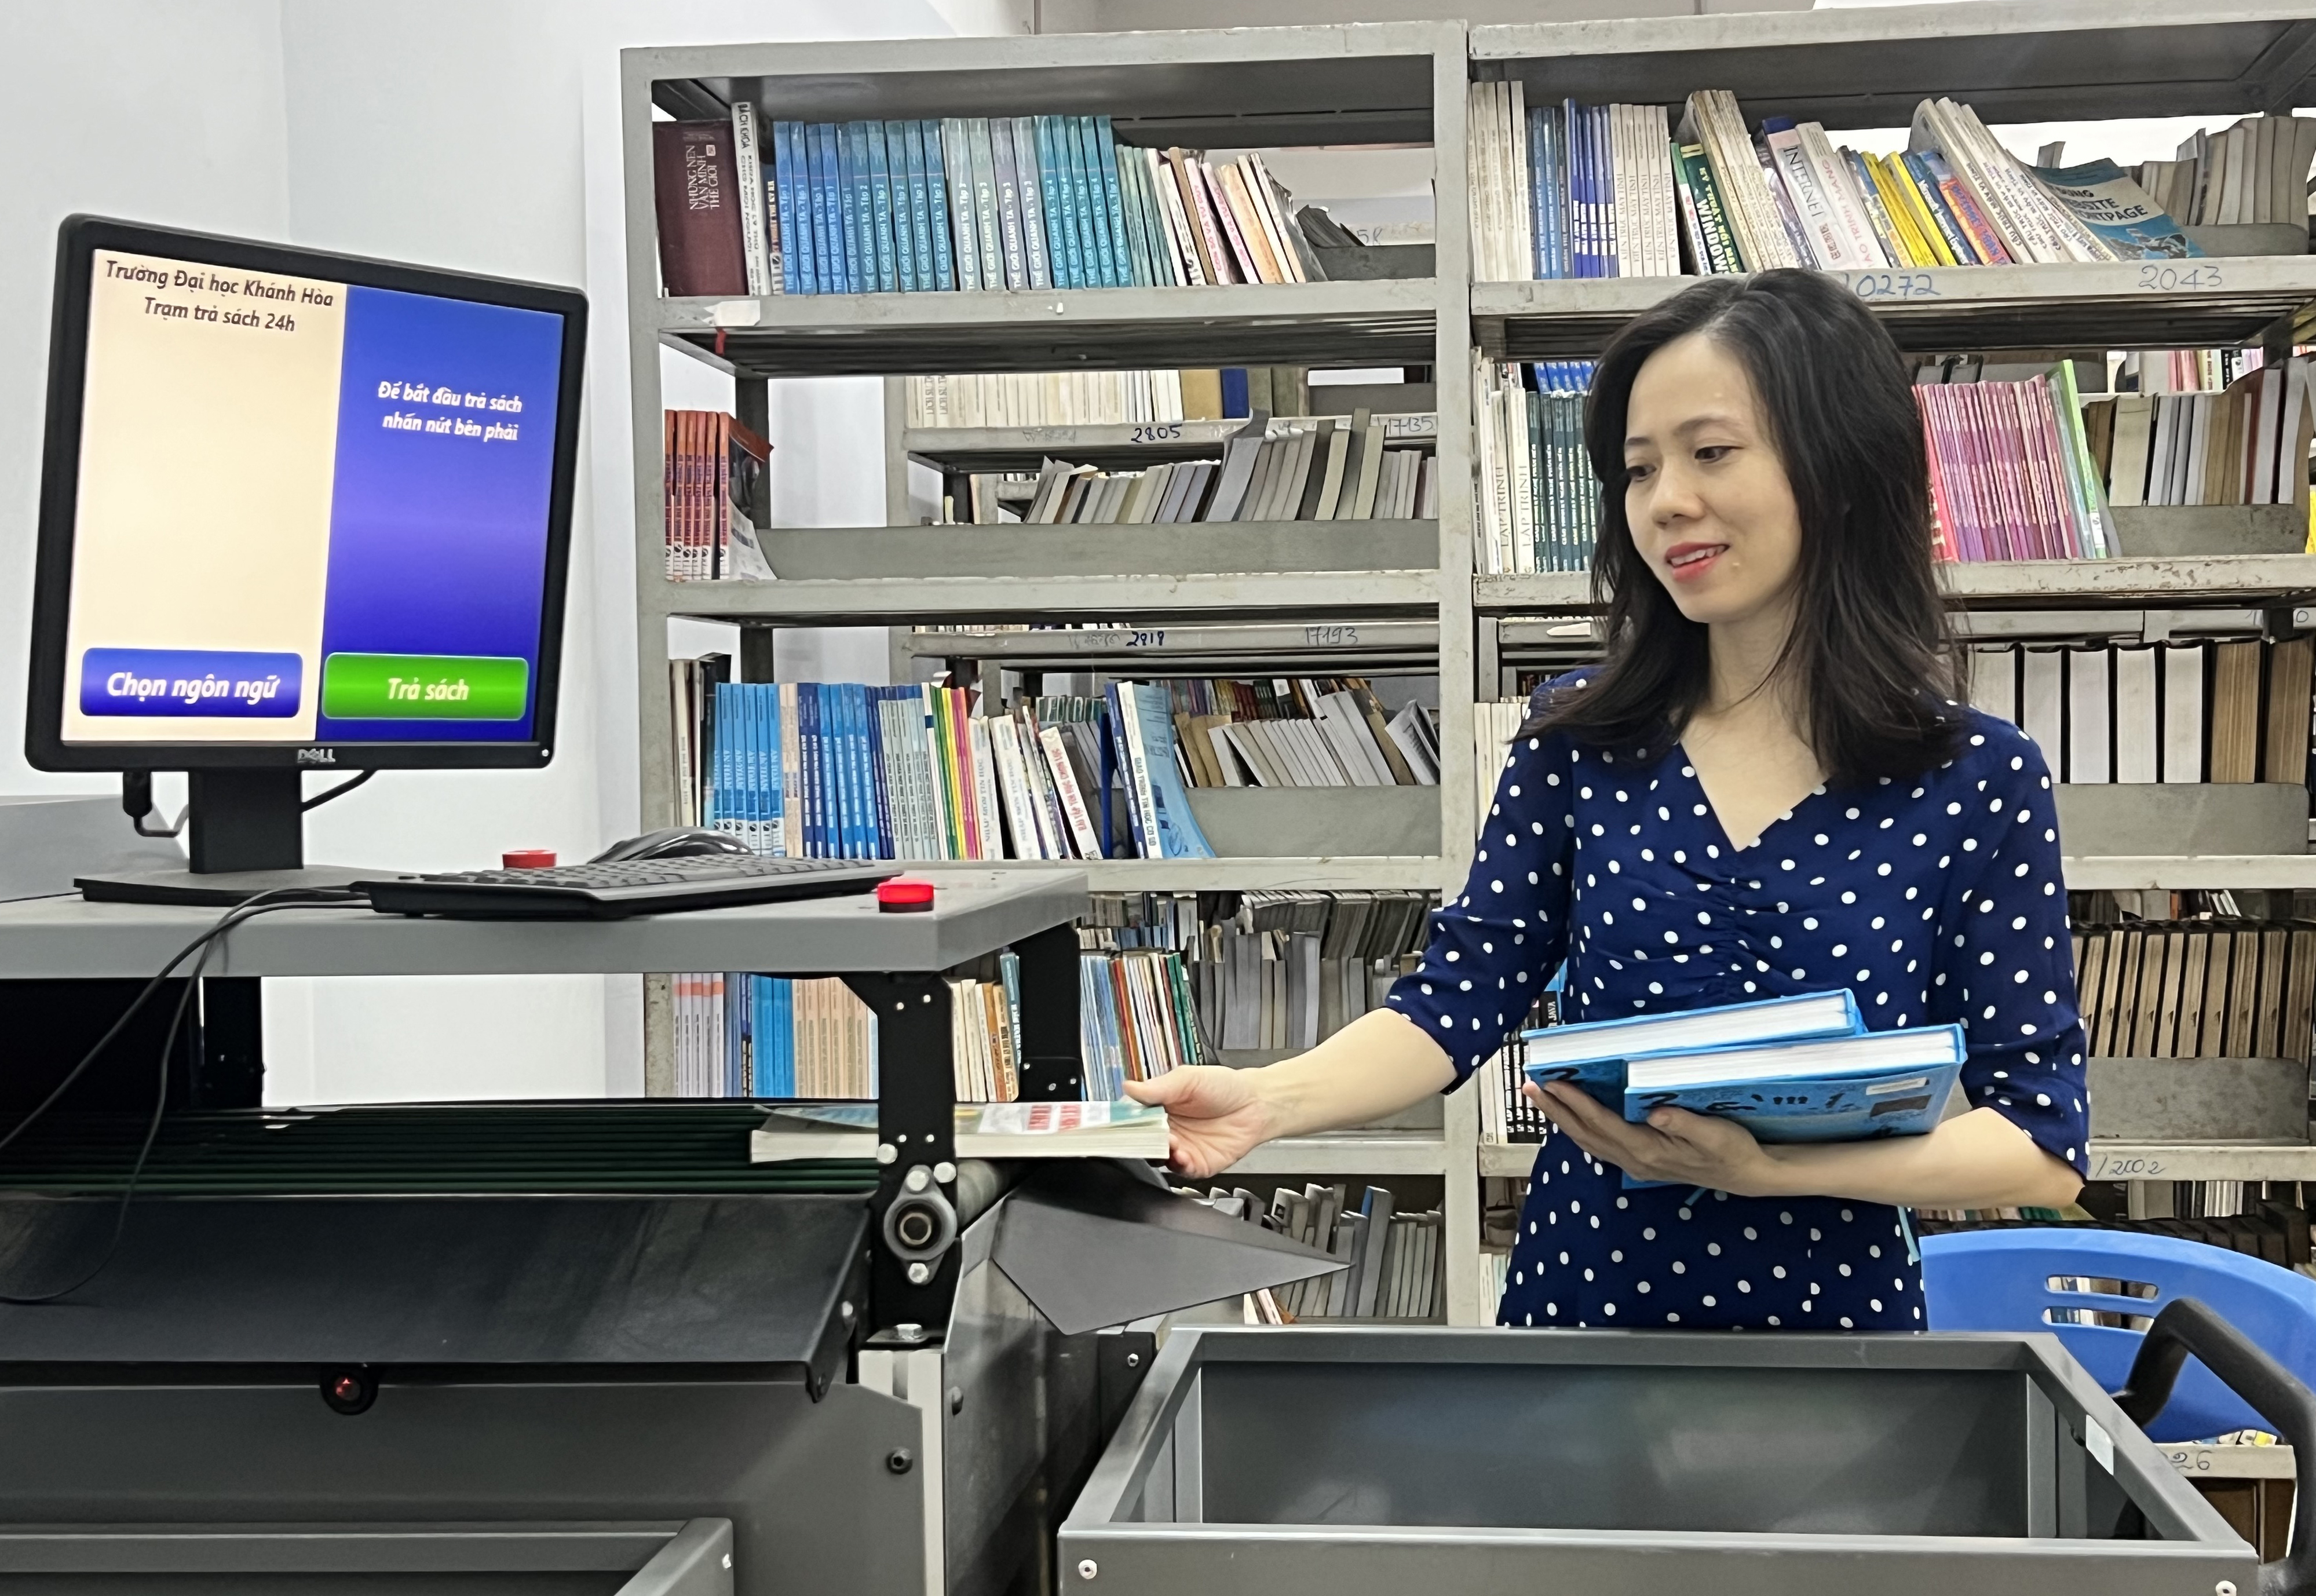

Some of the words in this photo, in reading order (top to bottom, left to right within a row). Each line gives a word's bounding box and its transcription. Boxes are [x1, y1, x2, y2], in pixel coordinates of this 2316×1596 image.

[107, 260, 168, 289] Trường
[174, 270, 204, 293] Đại
[209, 275, 239, 297] học
[244, 280, 295, 301] Khánh
[301, 288, 334, 306] Hòa
[2139, 264, 2223, 291] 2043
[145, 297, 188, 320] Trạm
[194, 305, 217, 322] trả
[223, 308, 260, 327] sách
[265, 313, 295, 331] 24h
[432, 387, 461, 406] đầu
[465, 392, 486, 408] trả
[489, 395, 523, 412] sách
[425, 417, 452, 433] nút
[454, 418, 481, 436] bên
[483, 422, 518, 442] phải
[1131, 424, 1183, 443] 2805
[1306, 627, 1358, 644] 17193
[107, 673, 166, 702] Chọn
[171, 674, 231, 704] ngôn
[235, 675, 281, 705] ngữ
[387, 677, 419, 700] Trả
[425, 679, 469, 700] sách
[298, 748, 335, 764] DELL
[1547, 1001, 1557, 1021] JAVA
